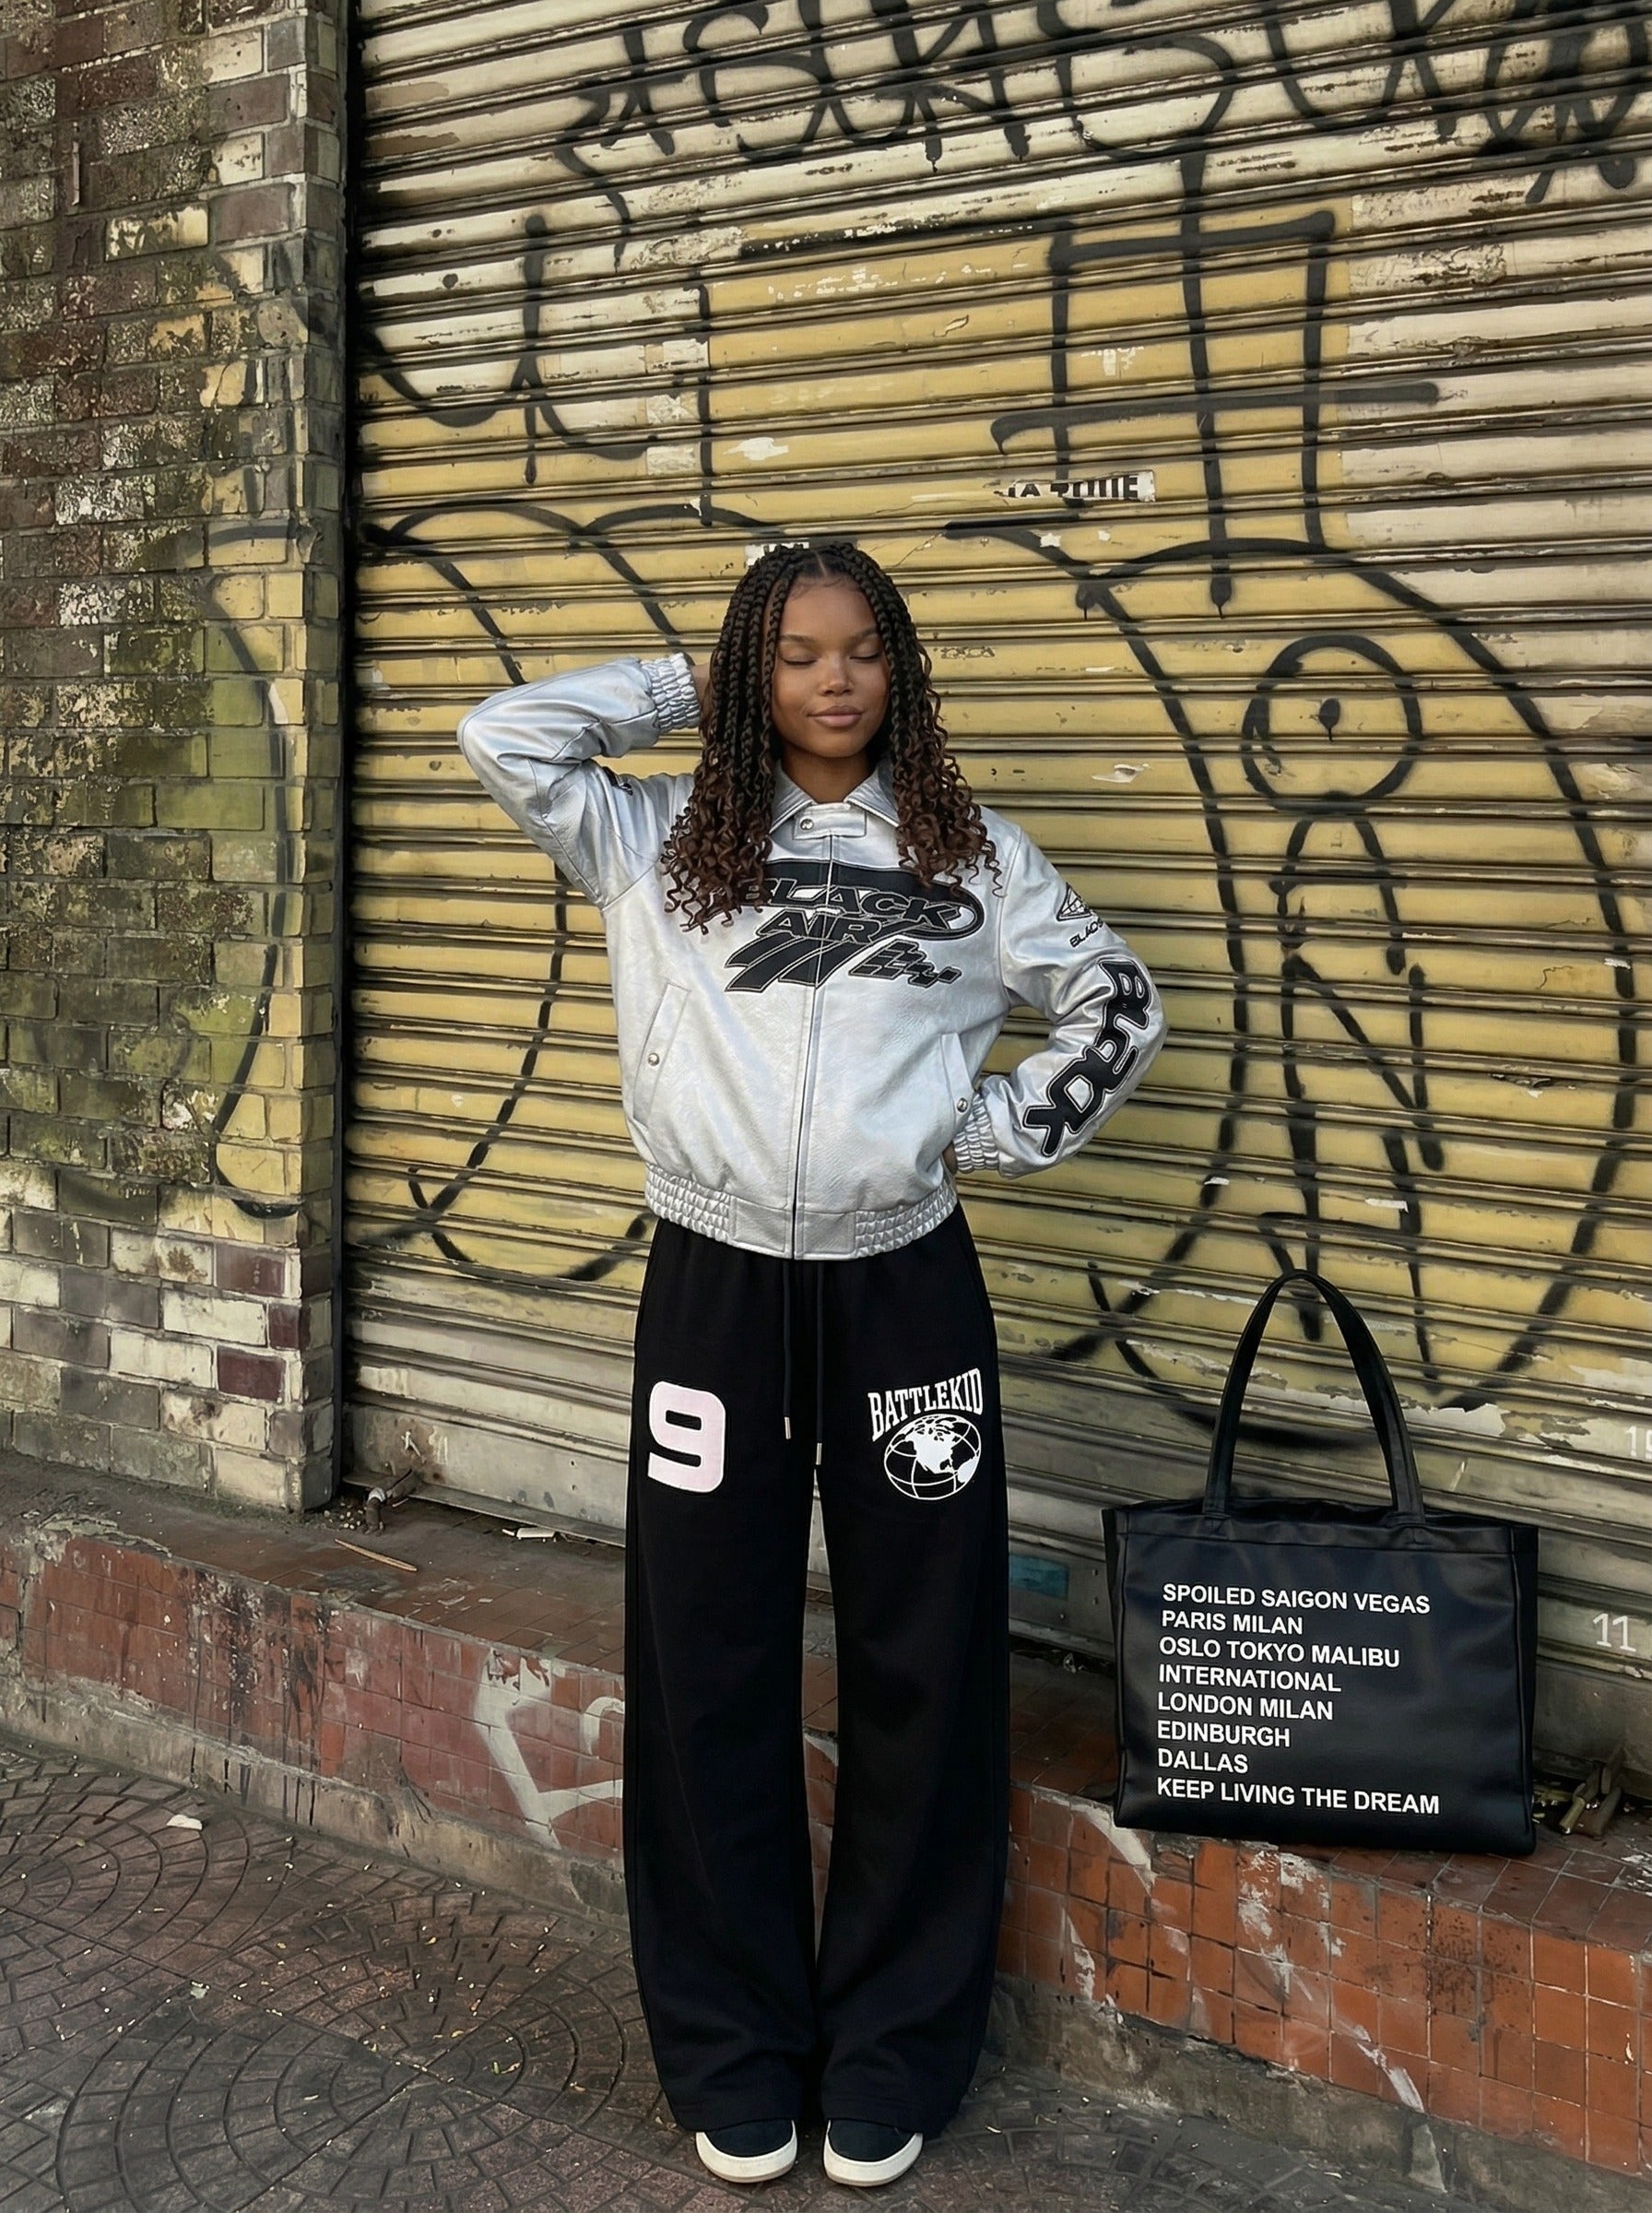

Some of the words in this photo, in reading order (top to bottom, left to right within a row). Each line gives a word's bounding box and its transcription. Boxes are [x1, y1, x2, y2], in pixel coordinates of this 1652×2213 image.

[756, 908, 882, 944] AIR
[867, 1367, 984, 1442] BATTLEKID
[647, 1380, 726, 1493] 9
[1162, 1583, 1256, 1605] SPOILED
[1261, 1589, 1348, 1610] SAIGON
[1352, 1592, 1431, 1615] VEGAS
[1162, 1609, 1226, 1631] PARIS
[1233, 1614, 1303, 1635] MILAN
[1592, 1613, 1636, 1652] 11
[1159, 1636, 1221, 1658] OSLO
[1226, 1640, 1304, 1663] TOKYO
[1311, 1644, 1400, 1668] MALIBU
[1159, 1663, 1342, 1692] INTERNATIONAL
[1158, 1691, 1253, 1716] LONDON
[1259, 1698, 1333, 1721] MILAN
[1157, 1719, 1290, 1747] EDINBURGH
[1158, 1747, 1248, 1774] DALLAS
[1157, 1776, 1215, 1800] KEEP
[1221, 1781, 1295, 1805] LIVING
[1301, 1787, 1348, 1809] THE
[1353, 1790, 1439, 1815] DREAM
